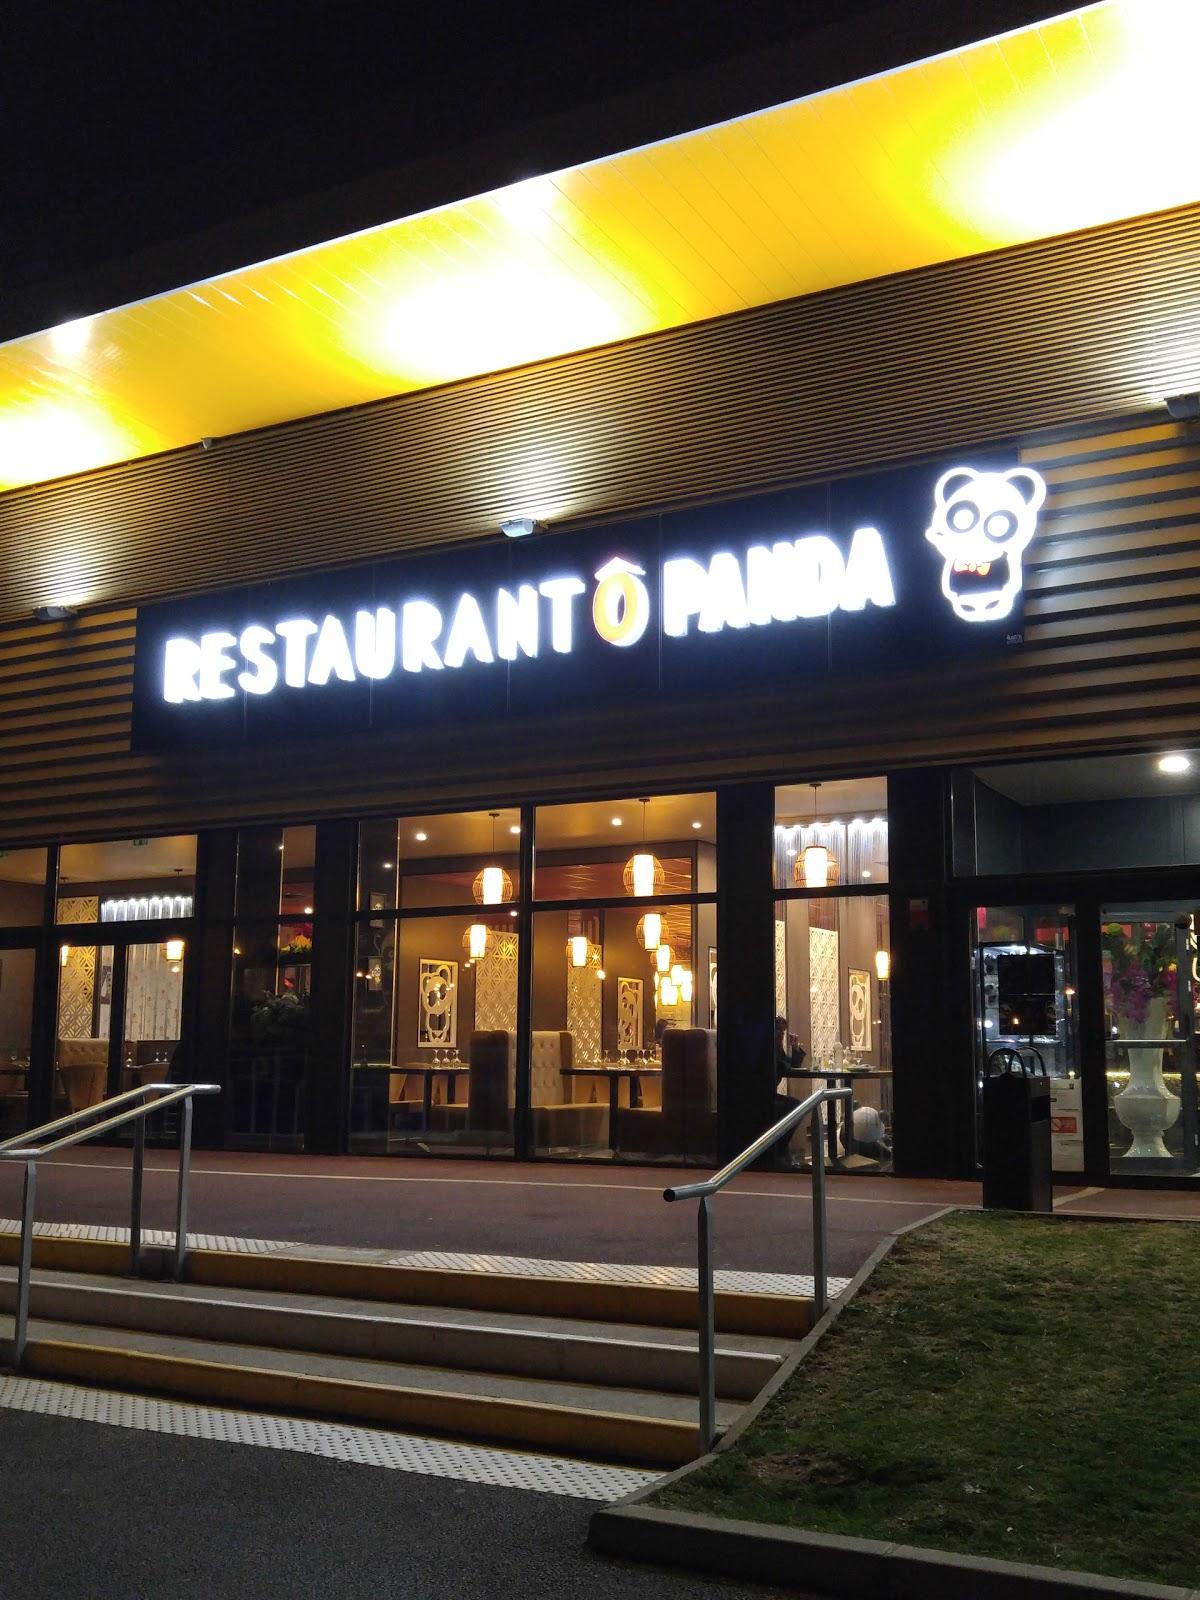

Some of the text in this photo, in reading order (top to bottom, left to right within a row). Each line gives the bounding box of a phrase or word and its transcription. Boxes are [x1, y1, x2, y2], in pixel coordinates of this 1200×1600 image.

[163, 526, 896, 704] RESTAURANT Ô PANDA
